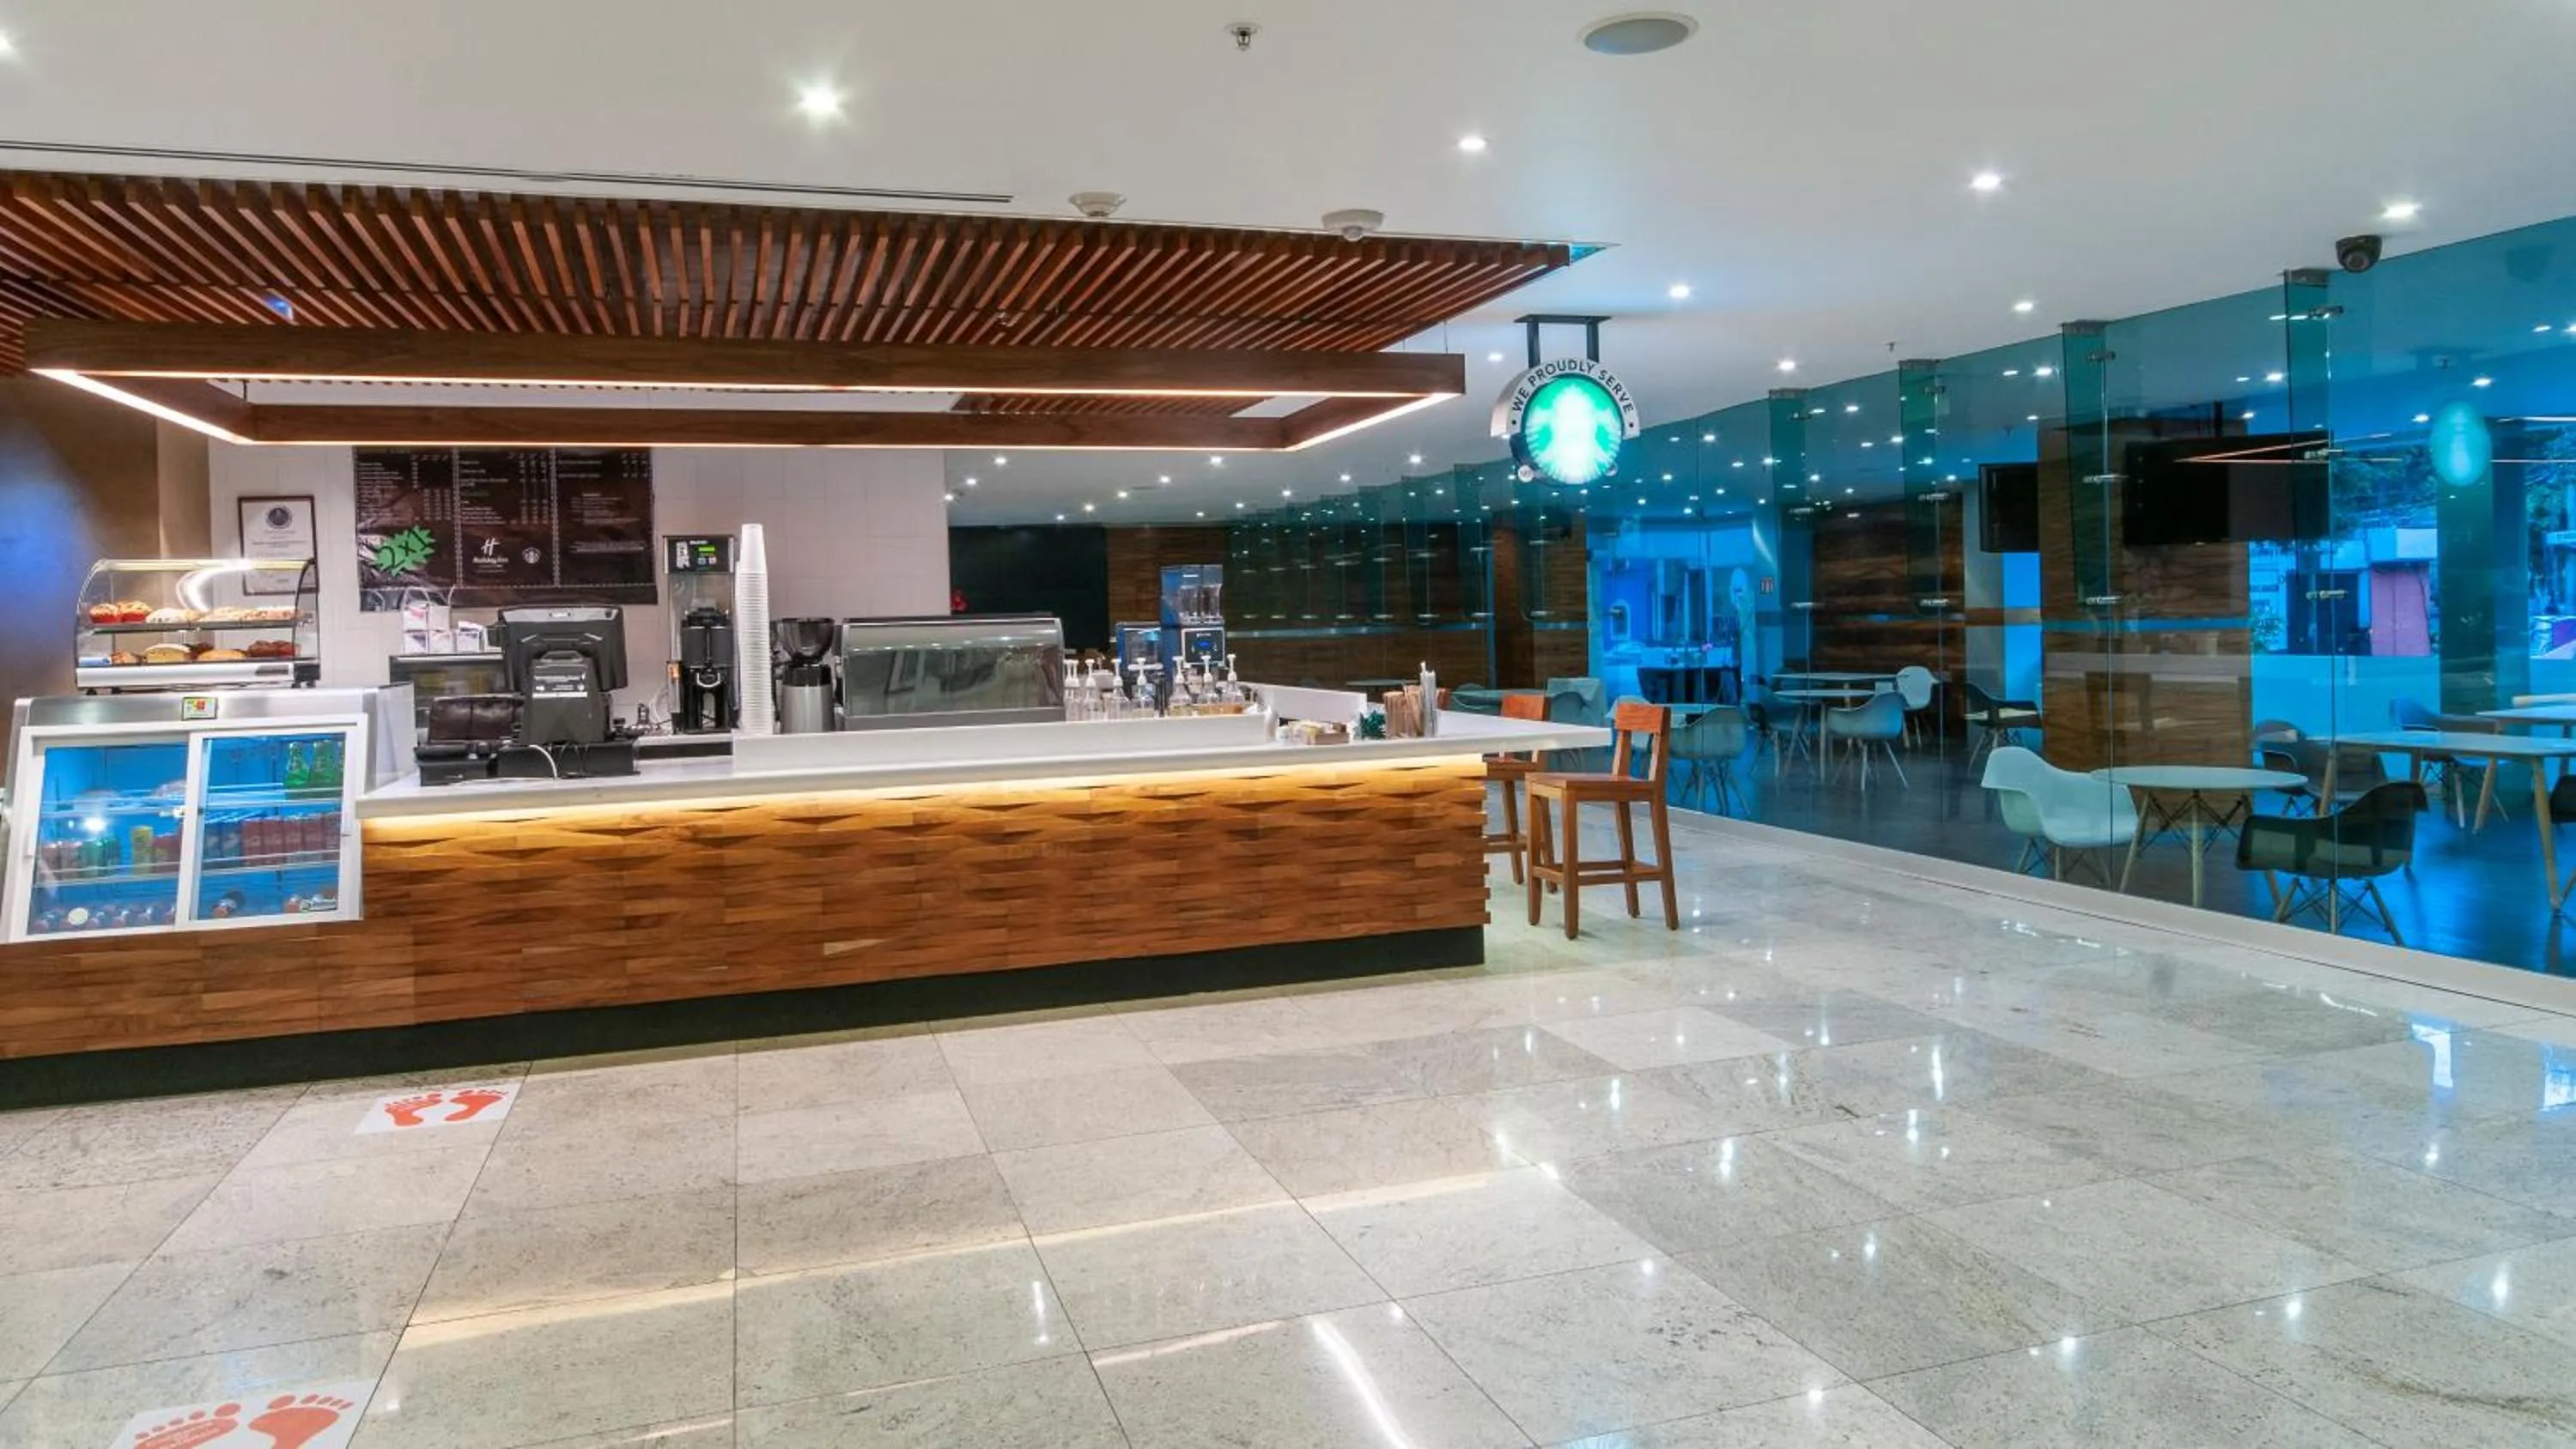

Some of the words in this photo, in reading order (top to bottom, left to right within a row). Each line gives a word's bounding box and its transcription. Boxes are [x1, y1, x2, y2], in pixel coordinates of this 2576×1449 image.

[1511, 387, 1529, 412] WE
[1528, 360, 1595, 386] PROUDLY
[1598, 370, 1634, 414] SERVE
